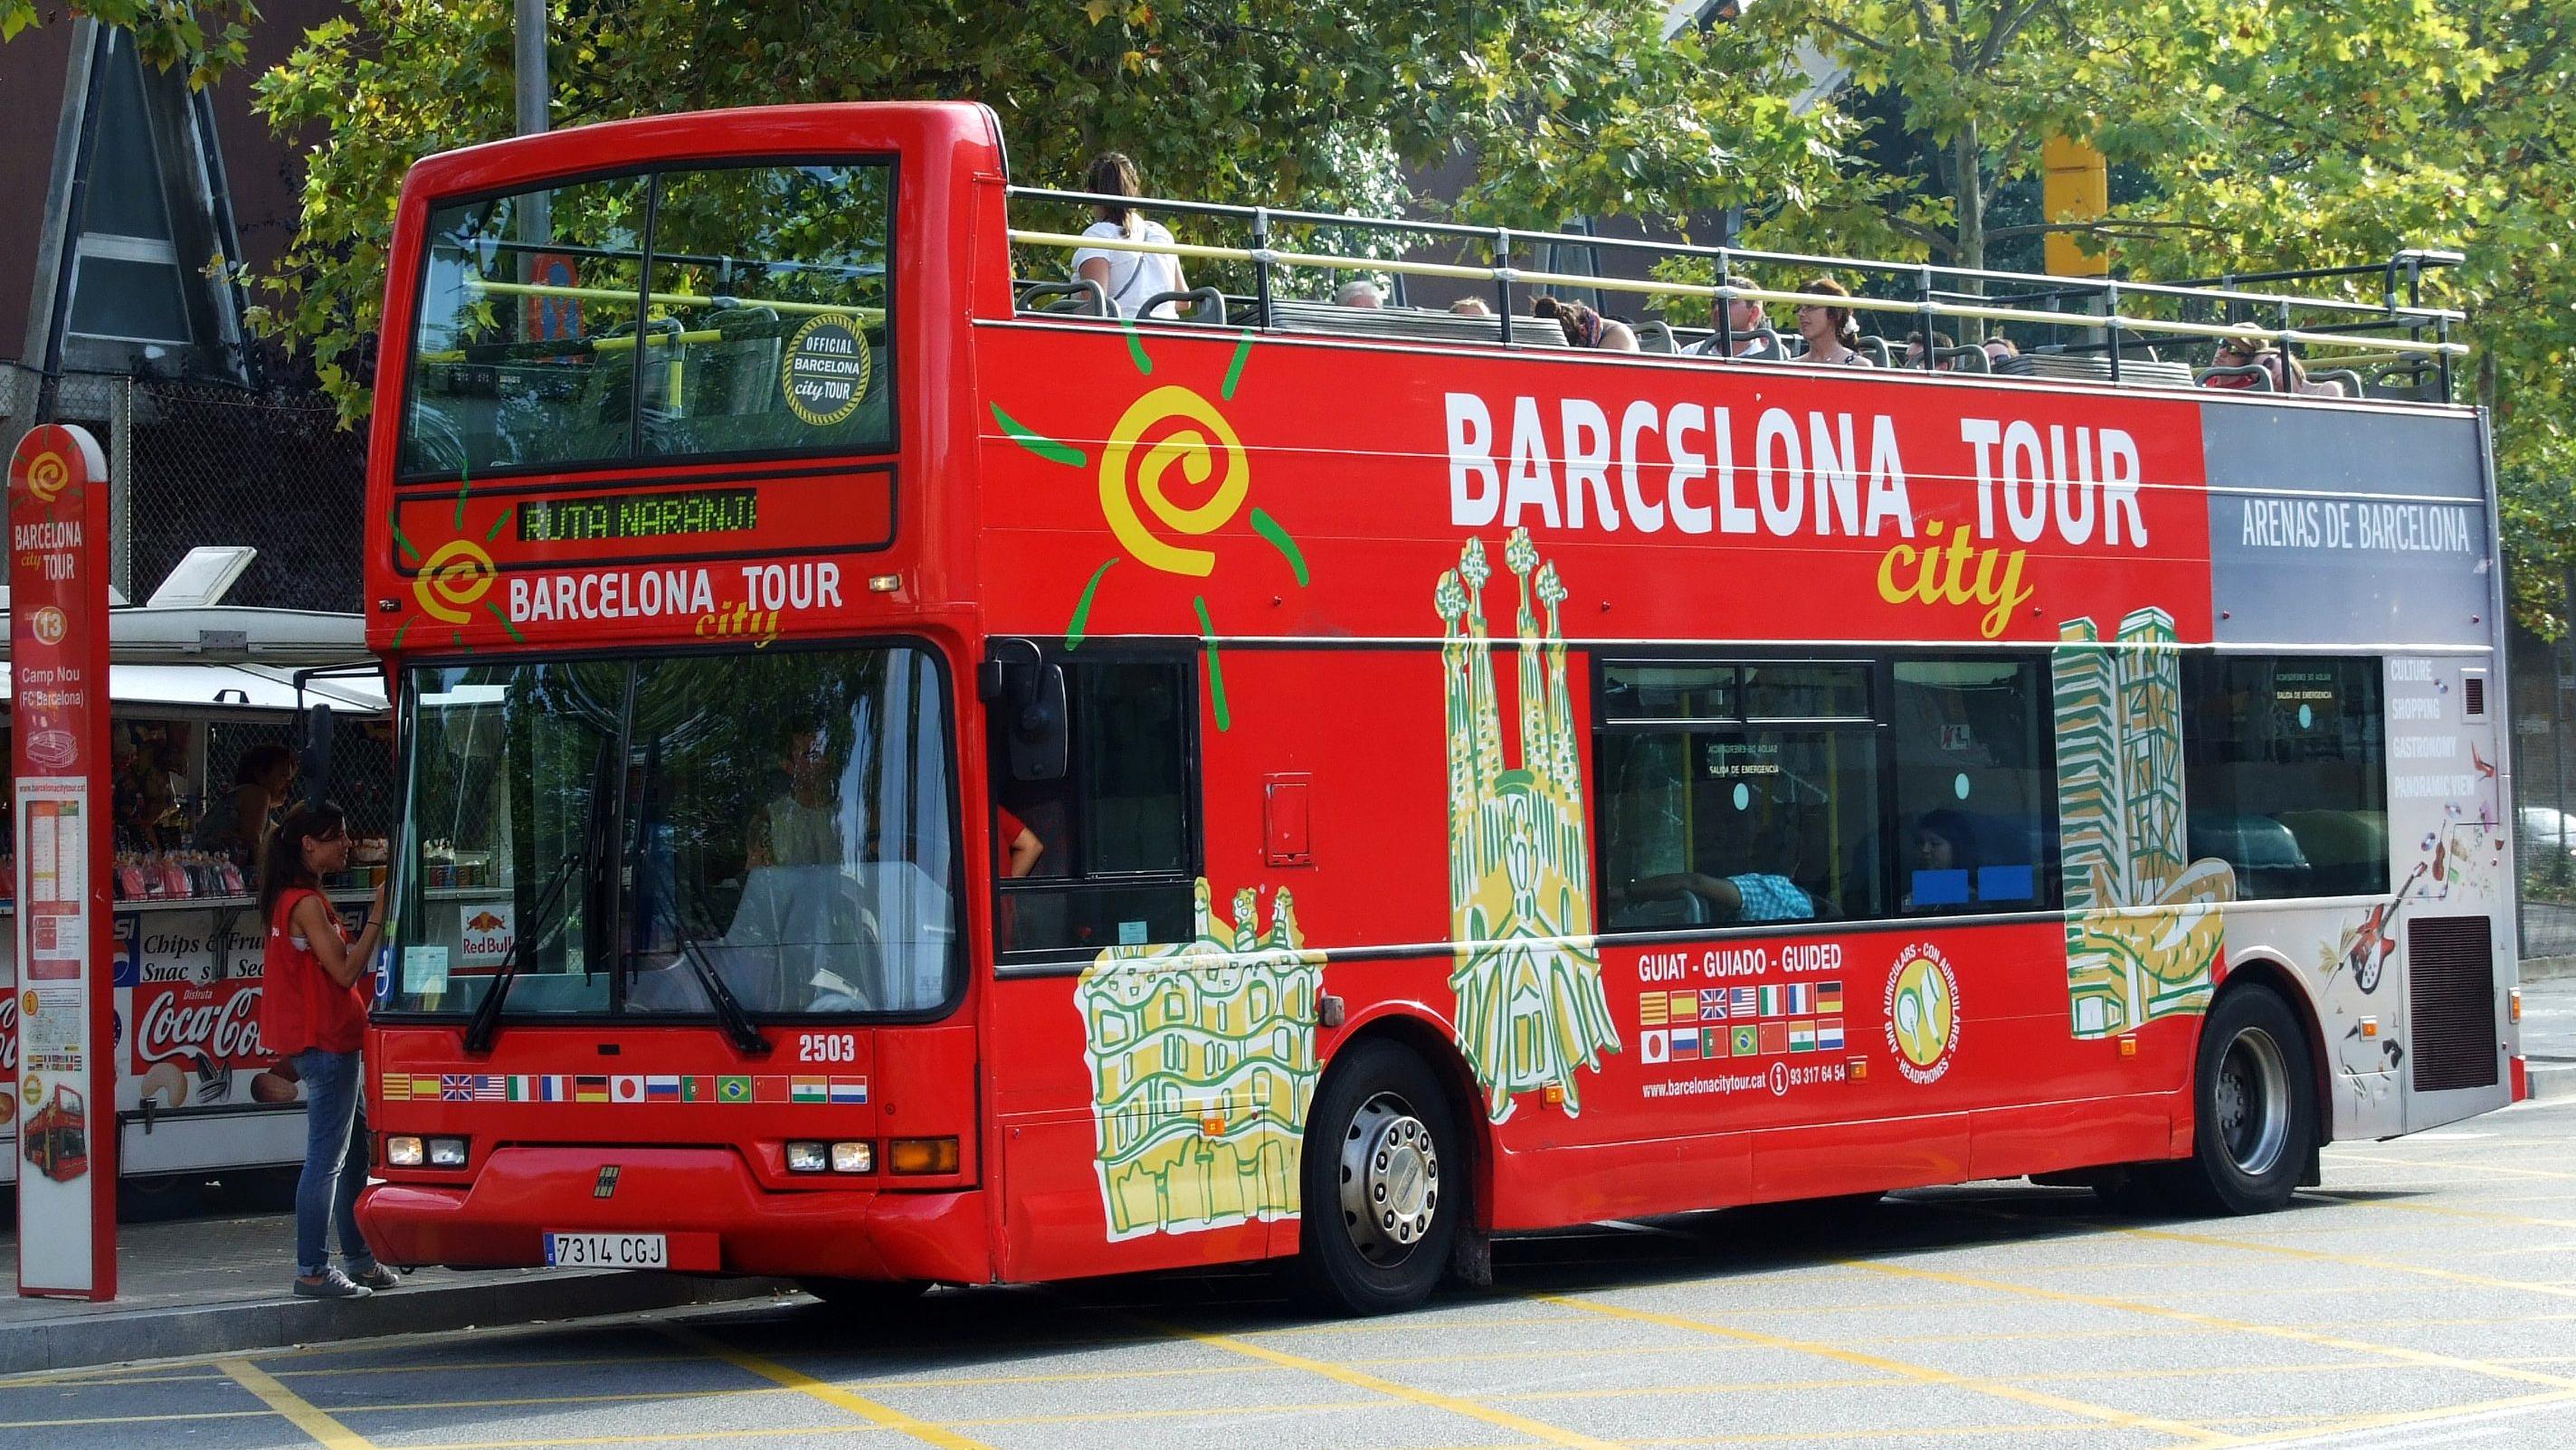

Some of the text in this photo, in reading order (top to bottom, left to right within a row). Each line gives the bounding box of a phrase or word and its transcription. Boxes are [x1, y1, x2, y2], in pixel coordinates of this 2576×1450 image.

[806, 336, 852, 354] OFFICIAL
[794, 358, 860, 375] BARCELONA
[794, 380, 851, 401] city TOUR
[1445, 392, 2149, 548] BARCELONA TOUR
[14, 521, 82, 551] BARCELONA
[525, 505, 608, 542] RUTA
[2242, 498, 2470, 552] ARENAS DE BARCELONA
[21, 551, 75, 581] city TOUR
[509, 562, 843, 623] BARCELONA TOUR
[1877, 519, 2034, 640] city
[40, 611, 62, 637] 13
[695, 599, 780, 649] city
[22, 666, 80, 686] Camp Nou
[2391, 659, 2433, 681] CULTURE
[19, 689, 84, 710] (FC Barcelona)
[2391, 698, 2440, 720] SHOPPING
[2393, 736, 2457, 759] GASTRONOMY
[1709, 764, 1779, 774] SALIDA DE EMERGENCIA
[2394, 774, 2476, 798] PANORAMIC VIEW
[144, 933, 200, 959] Chips
[463, 936, 512, 954] Red Bull
[1923, 943, 1940, 962] CON
[1639, 953, 1687, 982] GUIAT
[1704, 948, 1766, 978] GUIADO
[1782, 943, 1842, 971] GUIDED
[1883, 943, 1916, 1017] AURICULARS
[183, 990, 213, 1000] Disfruta
[1939, 957, 1961, 1053] AURICULARES
[799, 1034, 855, 1062] 2503
[1884, 1021, 1899, 1054] AMB
[1642, 1064, 1846, 1098] www.barcelonacitytour.cat 93 317 64 54
[1898, 1057, 1949, 1085] HEADPHONES
[548, 1253, 554, 1261] E
[558, 1237, 661, 1264] 7314 CGJ
